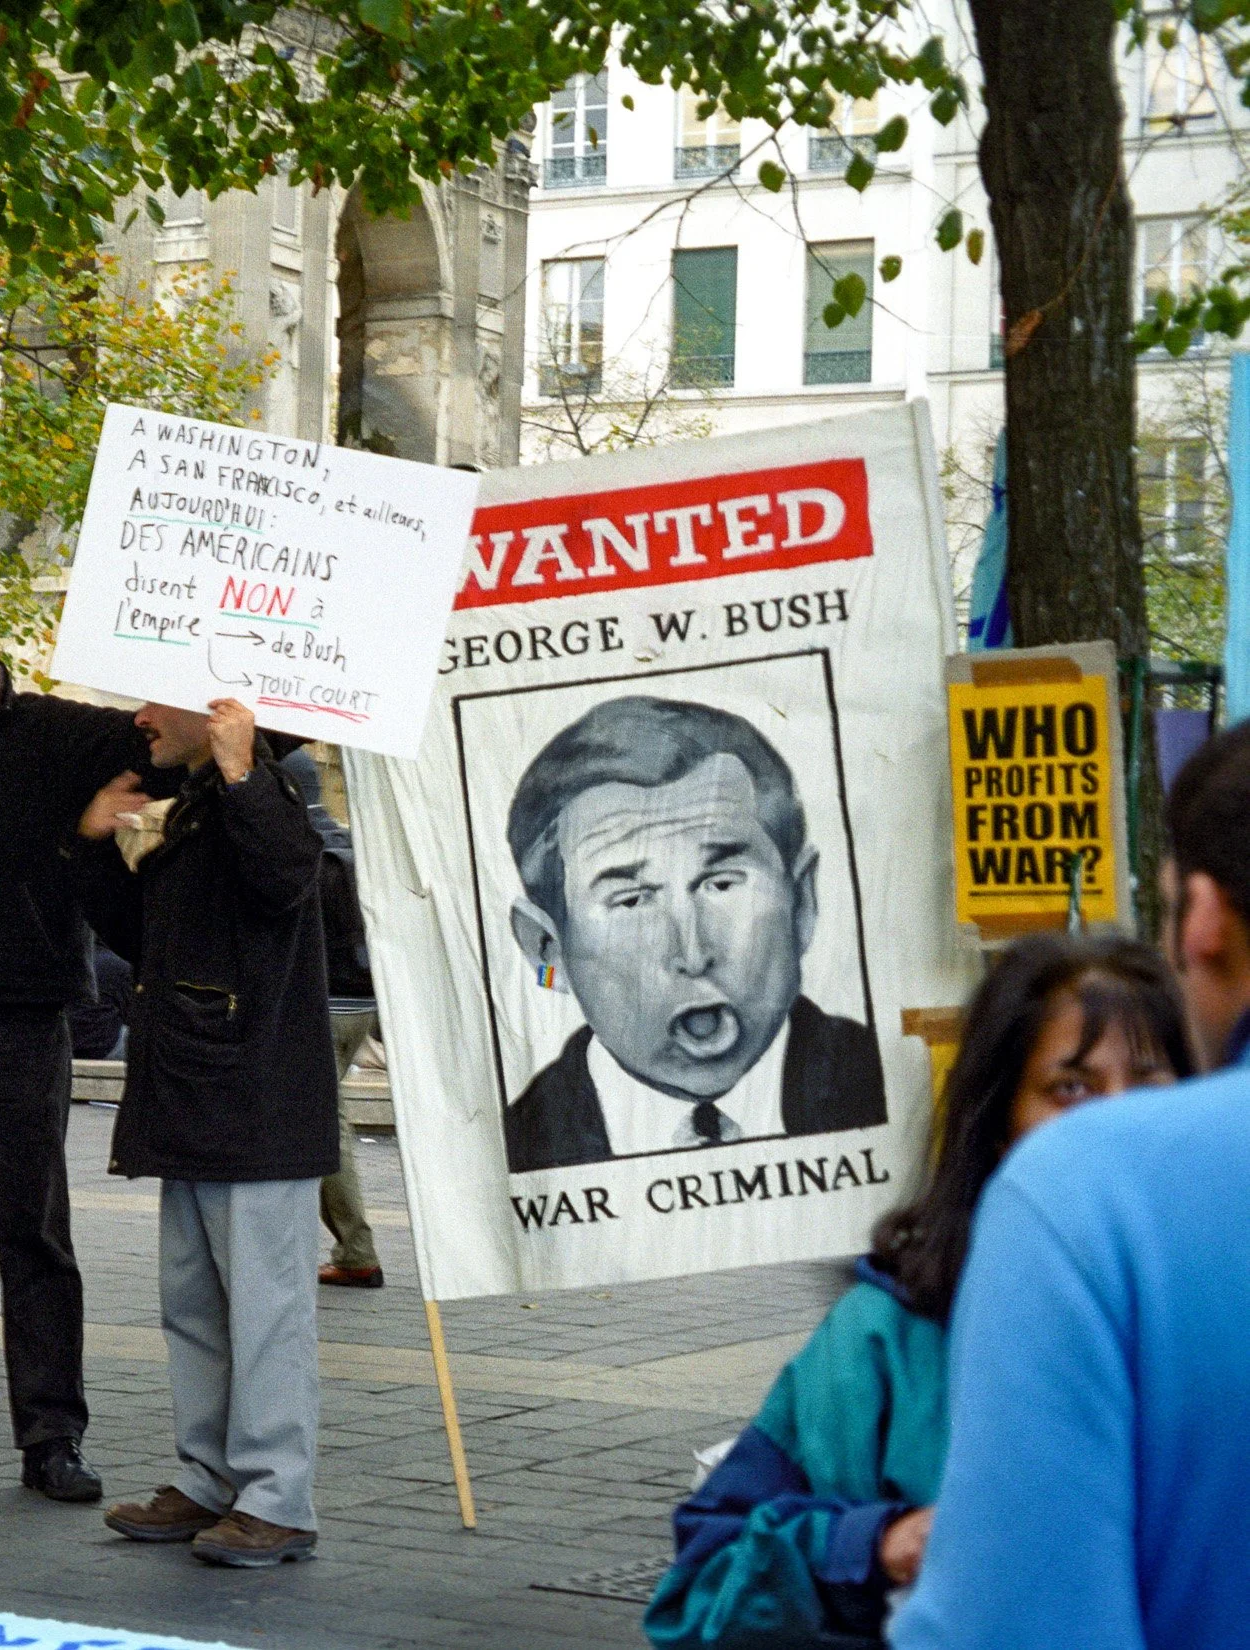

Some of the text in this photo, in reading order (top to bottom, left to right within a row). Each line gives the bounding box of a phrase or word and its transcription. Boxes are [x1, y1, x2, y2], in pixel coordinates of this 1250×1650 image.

[131, 417, 330, 482] A WASHINGTON,
[127, 449, 146, 470] A
[160, 455, 205, 480] SAN
[335, 494, 358, 514] et
[120, 520, 338, 582] DES AMÉRICAINS
[125, 560, 324, 619] disent NON à
[649, 610, 707, 644] W.
[724, 588, 850, 638] BUSH
[115, 597, 200, 642] l'empire
[271, 631, 347, 673] de Bush
[256, 673, 381, 712] TOUT COURT
[962, 702, 1098, 760] WHO
[965, 762, 1099, 798] PROFITS
[967, 801, 1099, 841] FROM
[968, 845, 1103, 886] WAR?
[510, 1148, 890, 1234] WAR CRIMINAL
